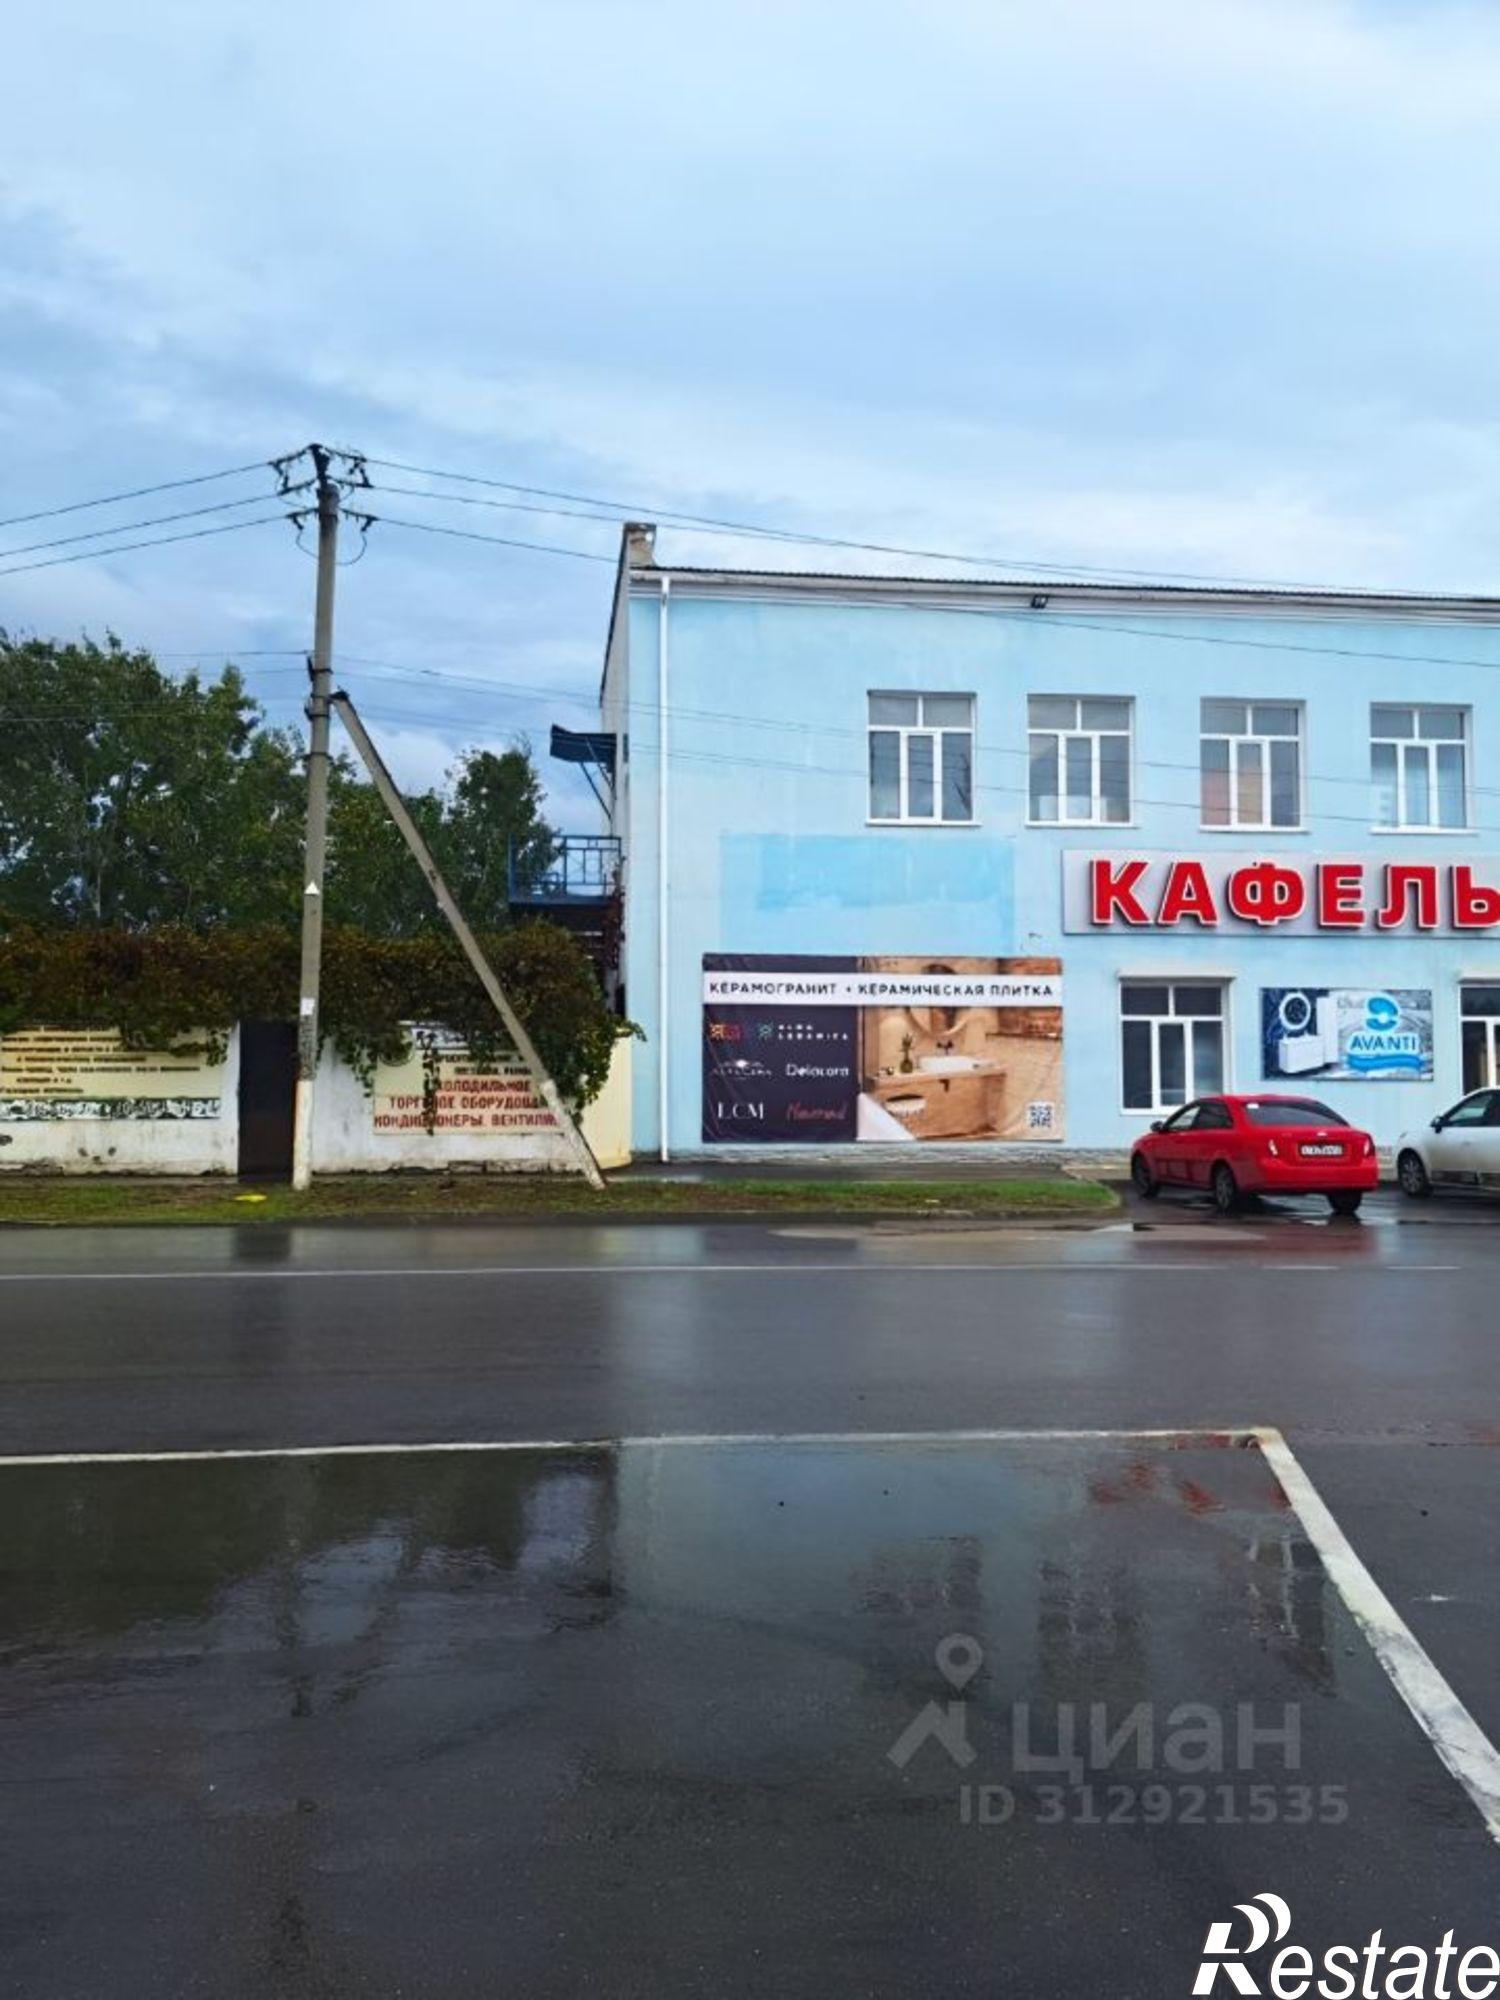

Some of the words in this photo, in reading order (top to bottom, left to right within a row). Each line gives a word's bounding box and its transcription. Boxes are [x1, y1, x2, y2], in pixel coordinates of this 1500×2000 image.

[1090, 859, 1500, 929] КАФЕЛЬ
[709, 982, 837, 995] КЕРАМОГРАНИТ
[857, 984, 984, 996] КЕРАМИЧЕСКАЯ
[990, 985, 1053, 997] ПЛИТКА
[1351, 1035, 1416, 1051] AVANTI
[435, 1080, 530, 1093] ОЛОДИЛЬНОЕ
[374, 1115, 483, 1128] КОНДИЦОНЕРЫ
